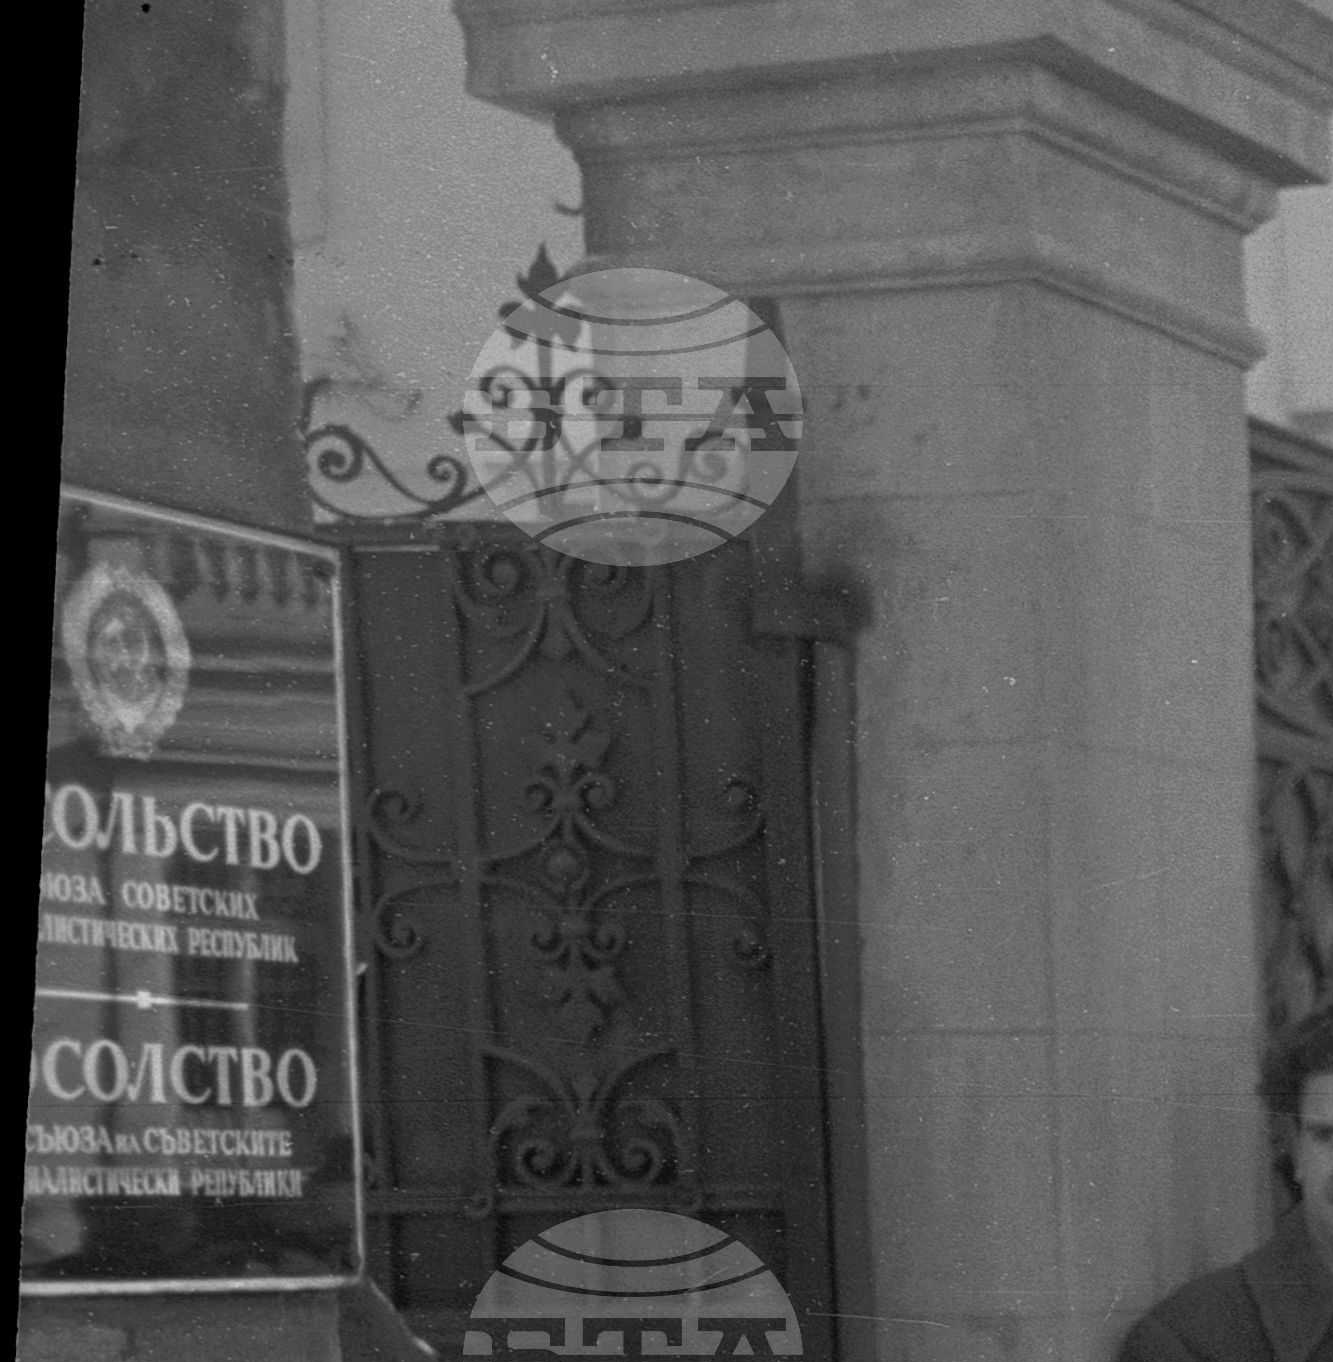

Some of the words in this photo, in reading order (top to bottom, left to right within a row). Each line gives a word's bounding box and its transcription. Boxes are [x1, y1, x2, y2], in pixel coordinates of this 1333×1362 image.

[121, 880, 260, 921] СОВЕТСКИХ
[187, 927, 299, 963] РЕСПУБЛИК
[30, 1035, 318, 1107] СОЛСТВО
[143, 1127, 294, 1157] СЪВЕТСКИТЕ
[190, 1168, 303, 1197] РЕПУБЛИКИ
